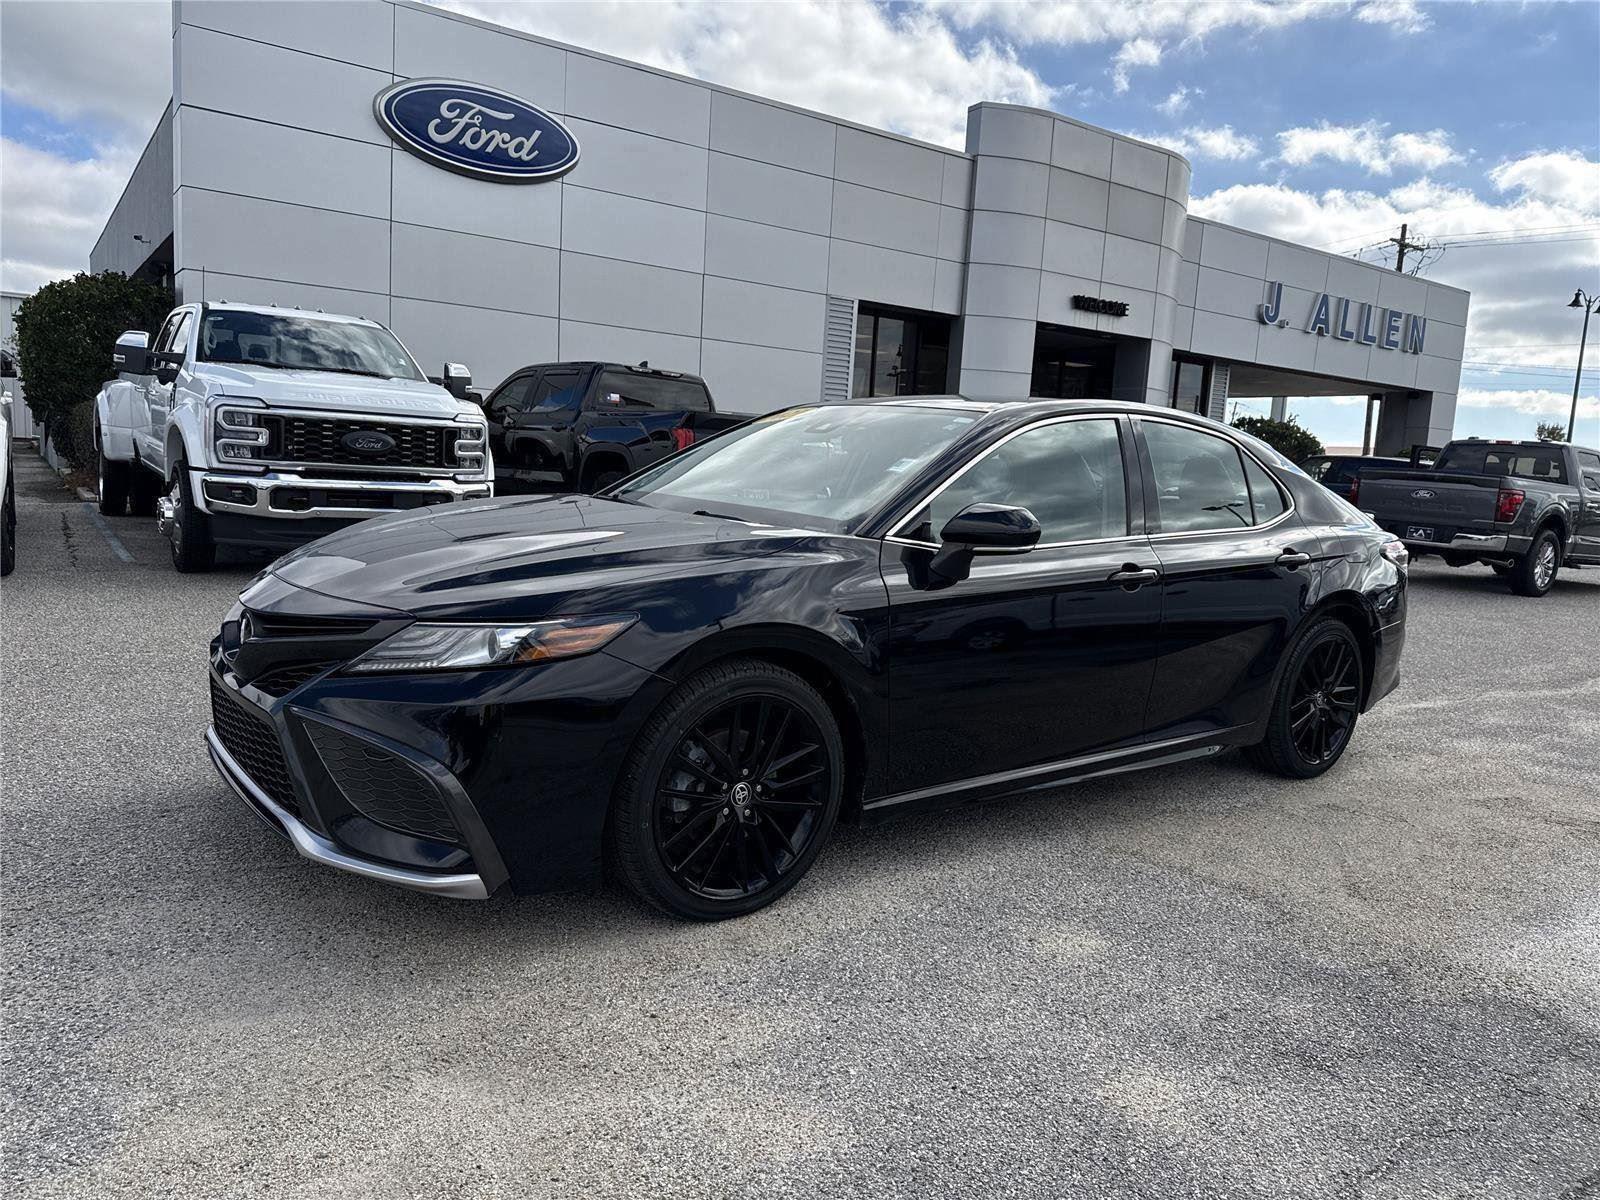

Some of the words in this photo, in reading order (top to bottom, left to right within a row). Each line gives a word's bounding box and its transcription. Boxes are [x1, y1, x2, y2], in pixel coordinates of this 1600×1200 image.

[428, 98, 542, 162] Ford
[1071, 294, 1130, 317] WELCOME
[1257, 280, 1290, 328] J.
[1306, 292, 1427, 354] ALLEN
[354, 437, 383, 449] Ford
